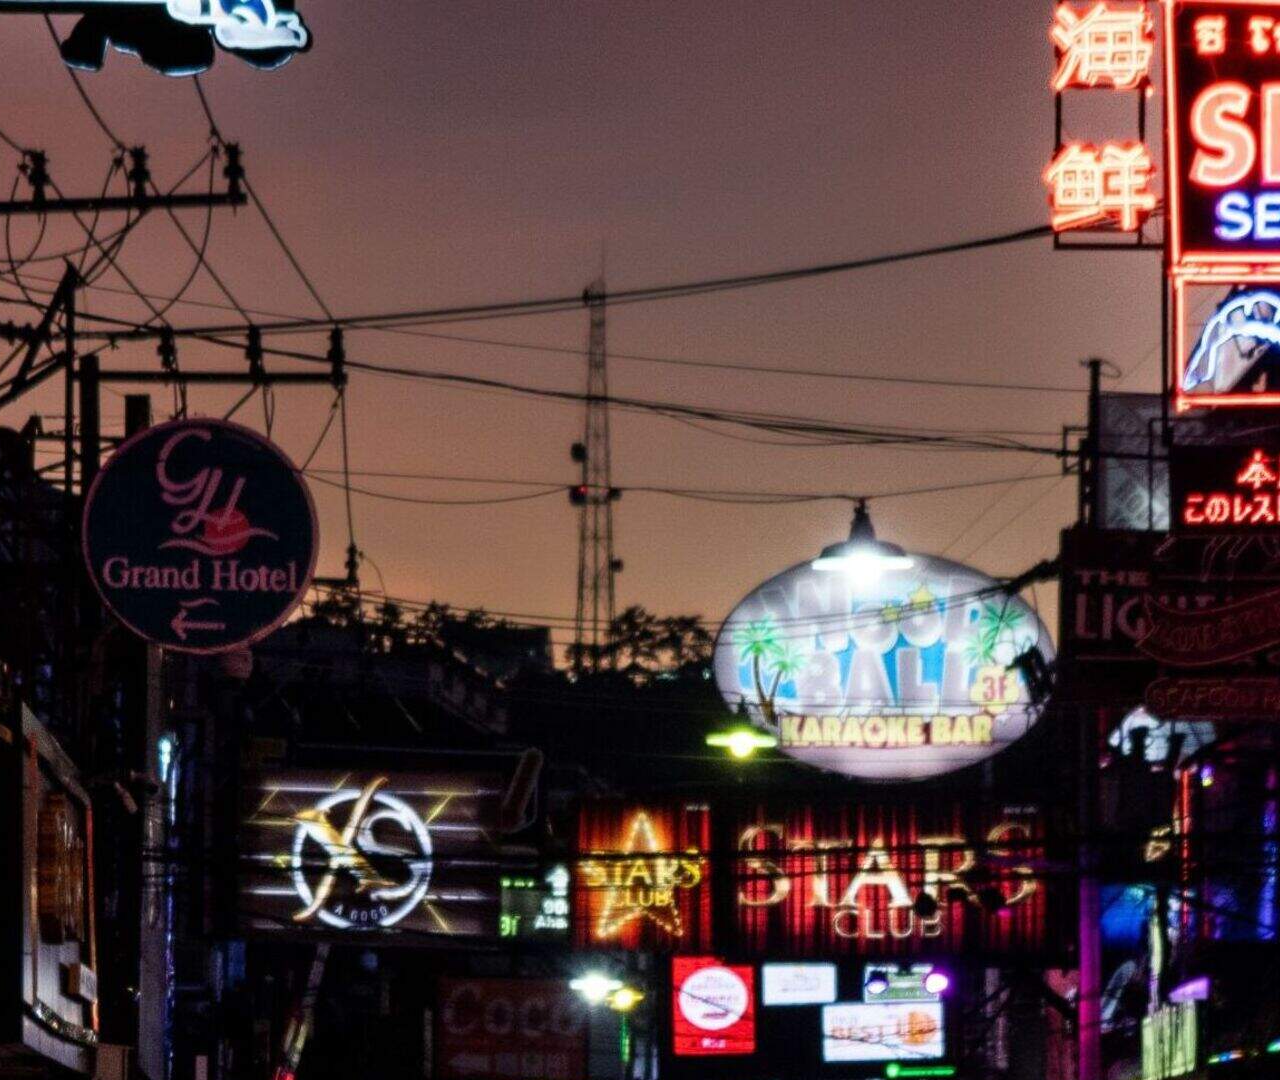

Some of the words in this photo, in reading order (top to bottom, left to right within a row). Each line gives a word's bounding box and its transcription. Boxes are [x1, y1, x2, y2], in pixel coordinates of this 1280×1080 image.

[102, 556, 200, 591] Grand
[211, 558, 298, 593] Hotel
[1075, 570, 1150, 586] THE
[780, 714, 926, 748] KARAOKE
[930, 712, 994, 744] BAR
[586, 853, 702, 889] STARS
[738, 822, 1038, 908] STARS
[612, 890, 674, 908] CLUB
[834, 908, 943, 939] CLUB
